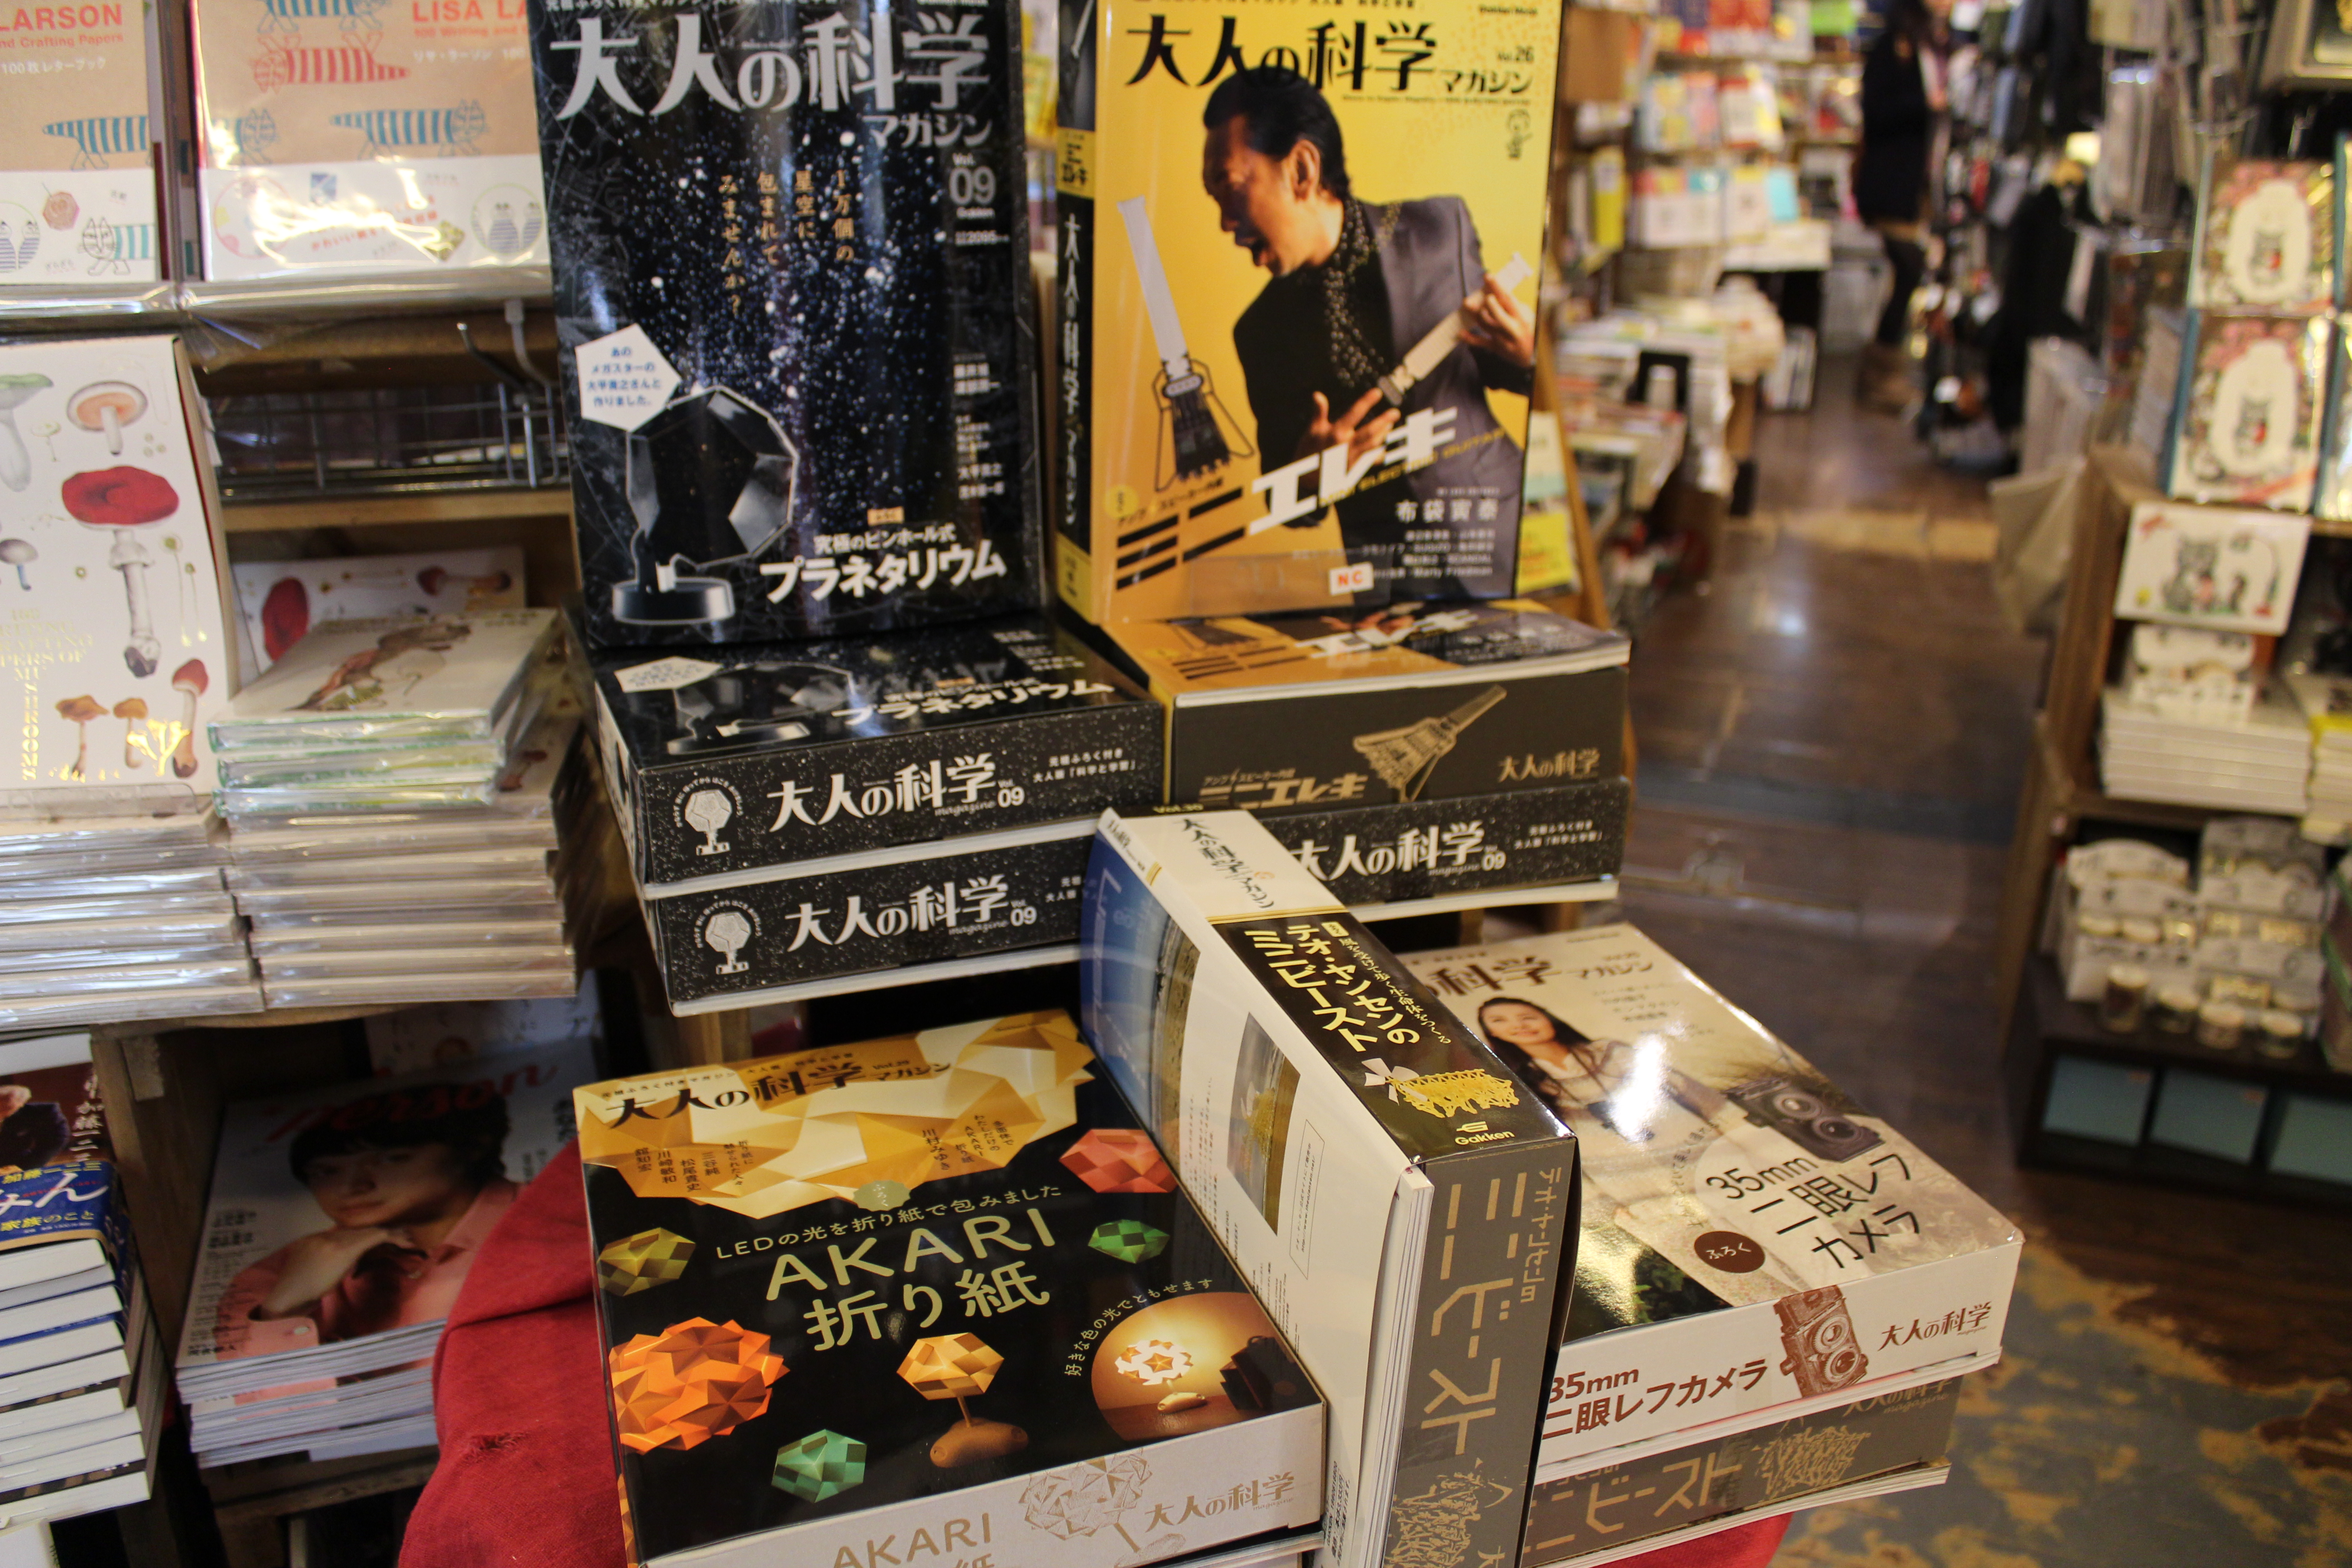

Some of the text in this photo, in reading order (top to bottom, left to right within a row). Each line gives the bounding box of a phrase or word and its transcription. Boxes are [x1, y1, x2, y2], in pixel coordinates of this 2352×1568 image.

[0, 4, 123, 31] ARSON
[0, 38, 15, 48] nd
[412, 0, 485, 22] LISA
[549, 12, 990, 121] 大人の科学
[1125, 15, 1533, 93] 大人の科学 マガジン
[863, 113, 992, 148] マガジン
[756, 171, 779, 266] 包まれて
[795, 170, 816, 240] 星空に
[832, 169, 855, 262] 1万個の
[950, 166, 996, 205] 09
[759, 539, 1007, 604] プラネタリウム
[831, 678, 1115, 725] プラネタリウム
[767, 752, 996, 832] 大人の科学
[998, 787, 1025, 808] 09
[1498, 747, 1601, 783] 大人の科学
[1294, 819, 1486, 883] 大人の科学
[1481, 850, 1507, 871] 09
[785, 872, 1010, 953] 大人の科学
[1009, 906, 1038, 927] 09
[1245, 929, 1378, 1053] ミニビースト
[1286, 925, 1420, 1045] テオ・ヤンセンの
[1338, 938, 1451, 1044] 風を受けて歩く生命体をつくる
[606, 1062, 951, 1129] 大人の科学 マガジン
[965, 1126, 985, 1156] AKARI
[1455, 1129, 1515, 1146] Gakken
[1706, 1156, 1818, 1199] 35mm
[1750, 1154, 1911, 1235] 二眼レフ
[717, 1185, 1062, 1259] LEDの光を折り紙で包みました
[765, 1207, 1055, 1300] AKARI
[1520, 1166, 1562, 1303] テオ・ヤンセンの
[1706, 1242, 1752, 1260] ふろく
[1812, 1205, 1920, 1268] カメラ
[806, 1260, 1051, 1352] 折り紙
[1064, 1279, 1213, 1377] 好きな色の光でともせます
[1420, 1172, 1527, 1455] ミニビースト
[1878, 1301, 1992, 1352] 大人の科学
[1543, 1358, 1768, 1440] 二眼レフカメラ
[1547, 1366, 1639, 1402] 35mm
[1144, 1469, 1295, 1532] 大人の科学
[833, 1513, 991, 1568] AKARI
